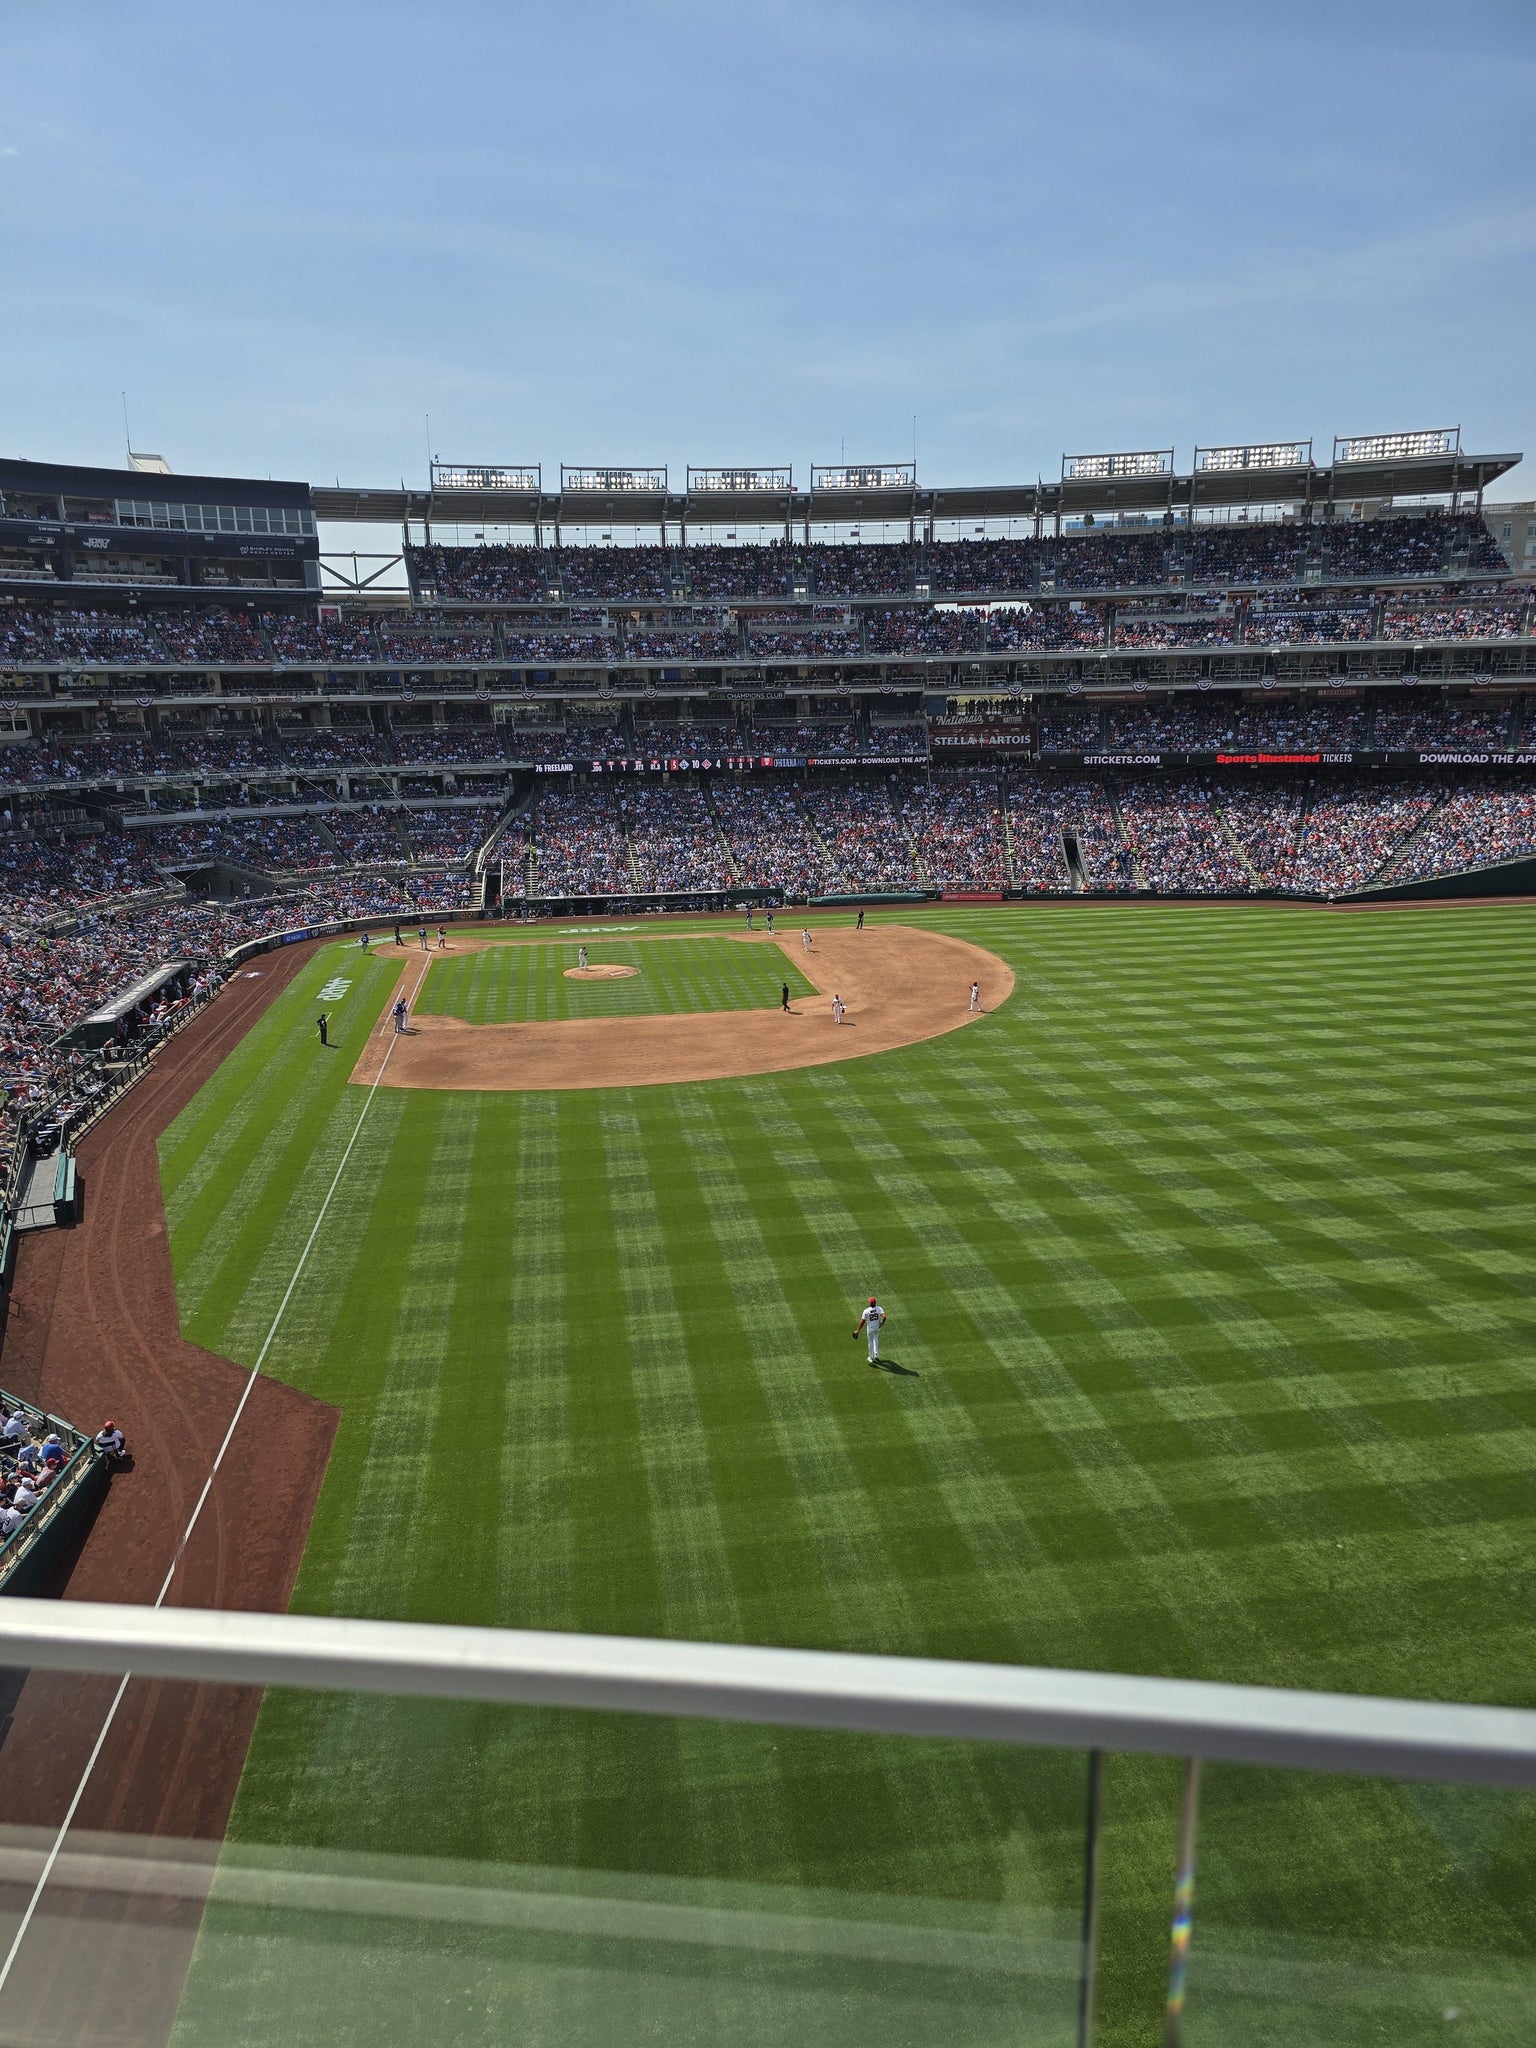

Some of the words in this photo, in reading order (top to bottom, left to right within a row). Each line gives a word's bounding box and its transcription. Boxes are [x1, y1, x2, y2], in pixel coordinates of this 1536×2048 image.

[935, 714, 984, 726] Nationals
[934, 736, 976, 746] STELLA
[988, 734, 1031, 745] ARTOIS
[692, 759, 700, 769] 10
[715, 759, 721, 768] 4
[808, 758, 857, 766] SITICKETS.COM
[862, 757, 900, 765] DOWNLOAD
[1083, 754, 1161, 765] SITICKETS.COM
[1216, 754, 1257, 764] Sports
[1258, 753, 1321, 764] Illustrated
[1322, 753, 1353, 763] TICKETS
[1419, 753, 1490, 764] DOWNLOAD
[1491, 753, 1514, 763] THE
[535, 764, 543, 773] 76
[544, 763, 574, 772] FREELAND
